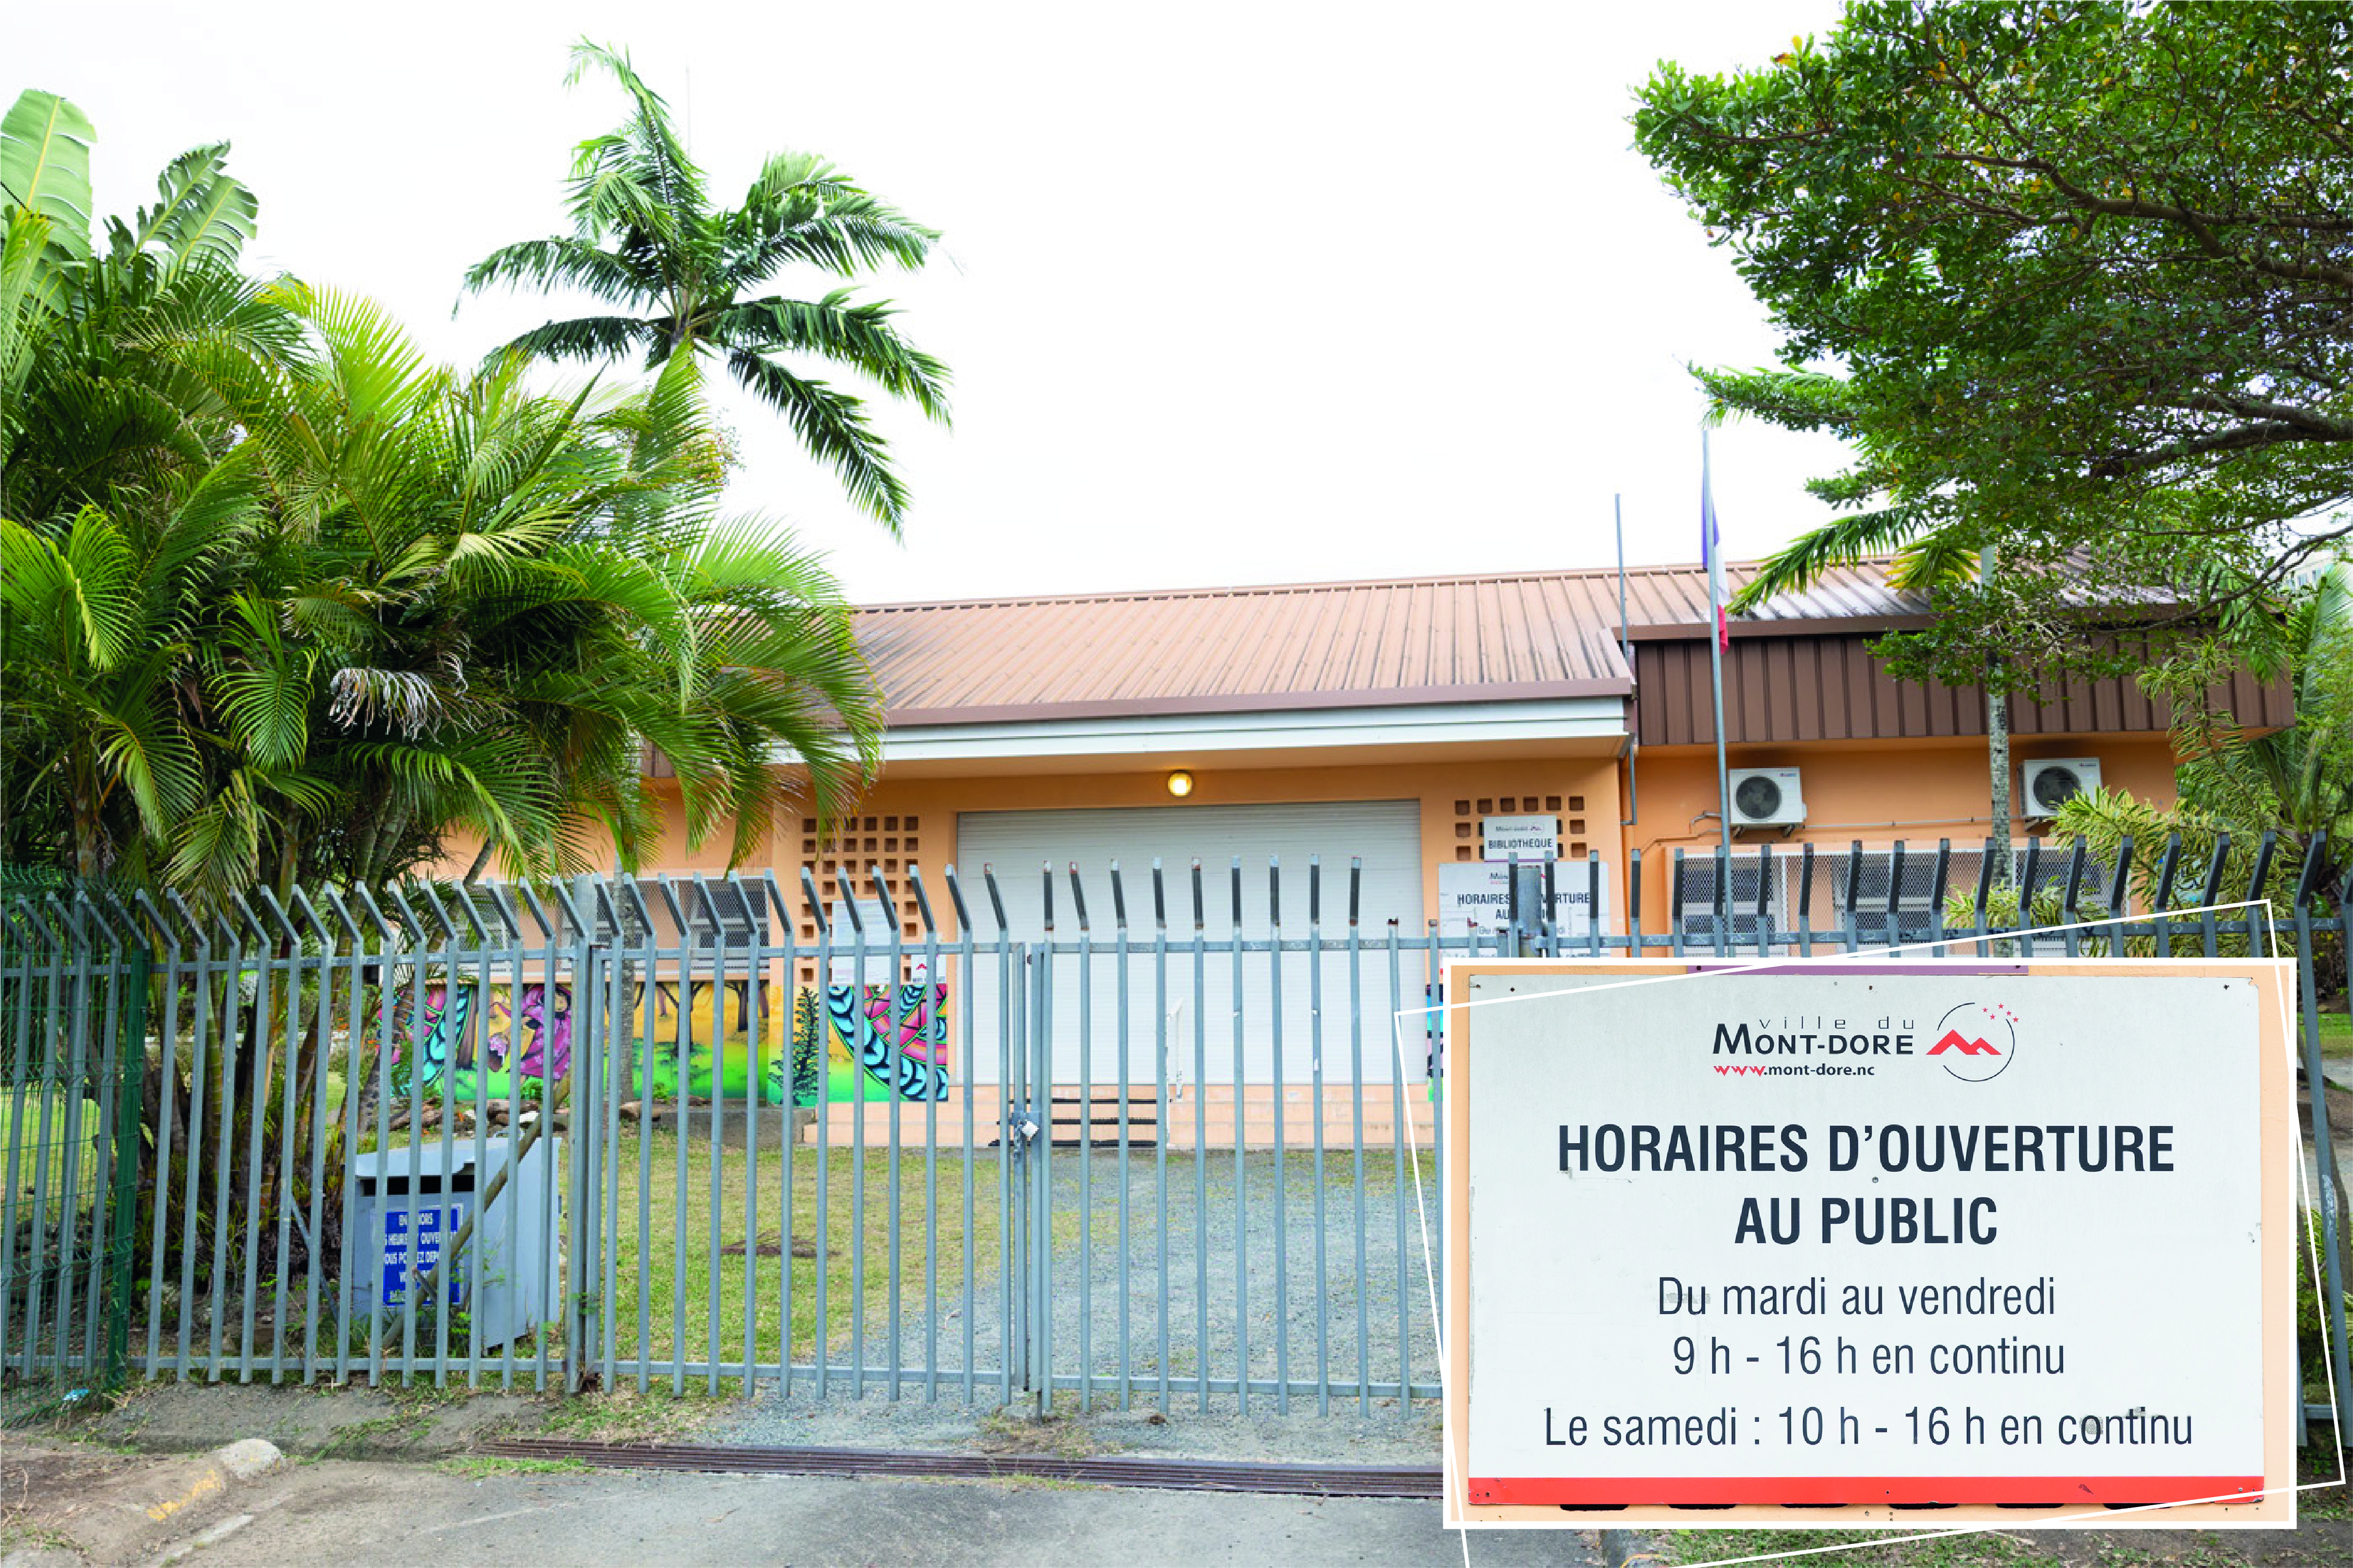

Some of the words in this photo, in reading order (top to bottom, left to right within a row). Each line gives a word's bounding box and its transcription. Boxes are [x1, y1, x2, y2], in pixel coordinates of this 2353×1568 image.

[1712, 1023, 1914, 1055] MONT-DORE
[1759, 1015, 1846, 1030] ville
[1878, 1015, 1914, 1030] du
[1714, 1063, 1874, 1077] www.mont-dore.nc
[1559, 1124, 1808, 1172] HORAIRES
[1734, 1198, 1800, 1245] AU
[1822, 1197, 1997, 1245] PUBLIC
[1659, 1277, 1706, 1316] Du
[1724, 1277, 1825, 1316] mardi
[1842, 1285, 1882, 1316] au
[1899, 1277, 2054, 1316] vendredi
[1674, 1336, 1695, 1375] 9
[1712, 1336, 1730, 1374] h
[1777, 1336, 1821, 1375] 16
[1838, 1336, 1856, 1374] h
[1873, 1344, 1913, 1375] en
[1931, 1336, 2064, 1375] continu
[1546, 1408, 1587, 1446] Le
[1604, 1407, 1736, 1446] samedi
[1779, 1407, 1823, 1445] 10
[1840, 1407, 1858, 1444] h
[1905, 1406, 1950, 1445] 16
[1966, 1407, 1984, 1444] h
[2001, 1415, 2042, 1445] en
[2059, 1406, 2192, 1445] continu
